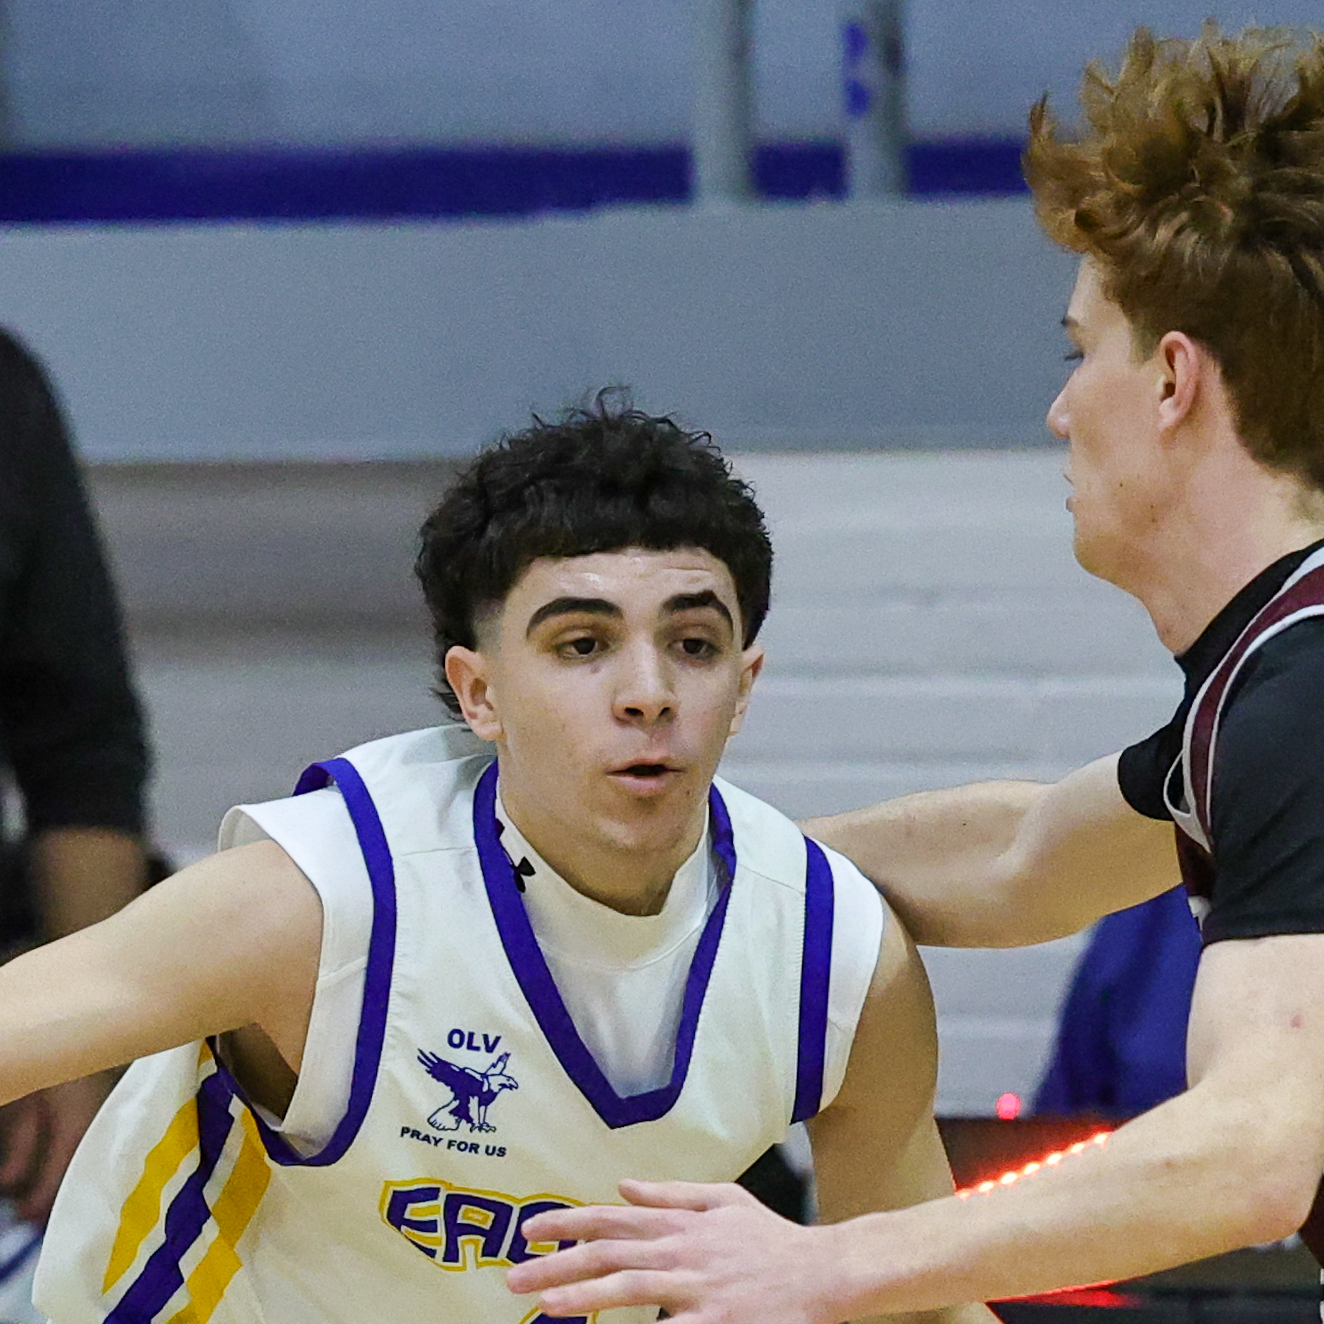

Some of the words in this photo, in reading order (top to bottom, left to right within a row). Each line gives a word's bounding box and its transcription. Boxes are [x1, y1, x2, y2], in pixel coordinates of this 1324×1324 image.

[447, 1028, 502, 1054] OLV
[400, 1126, 444, 1147] PRAY
[446, 1139, 481, 1154] FOR
[484, 1144, 507, 1157] US
